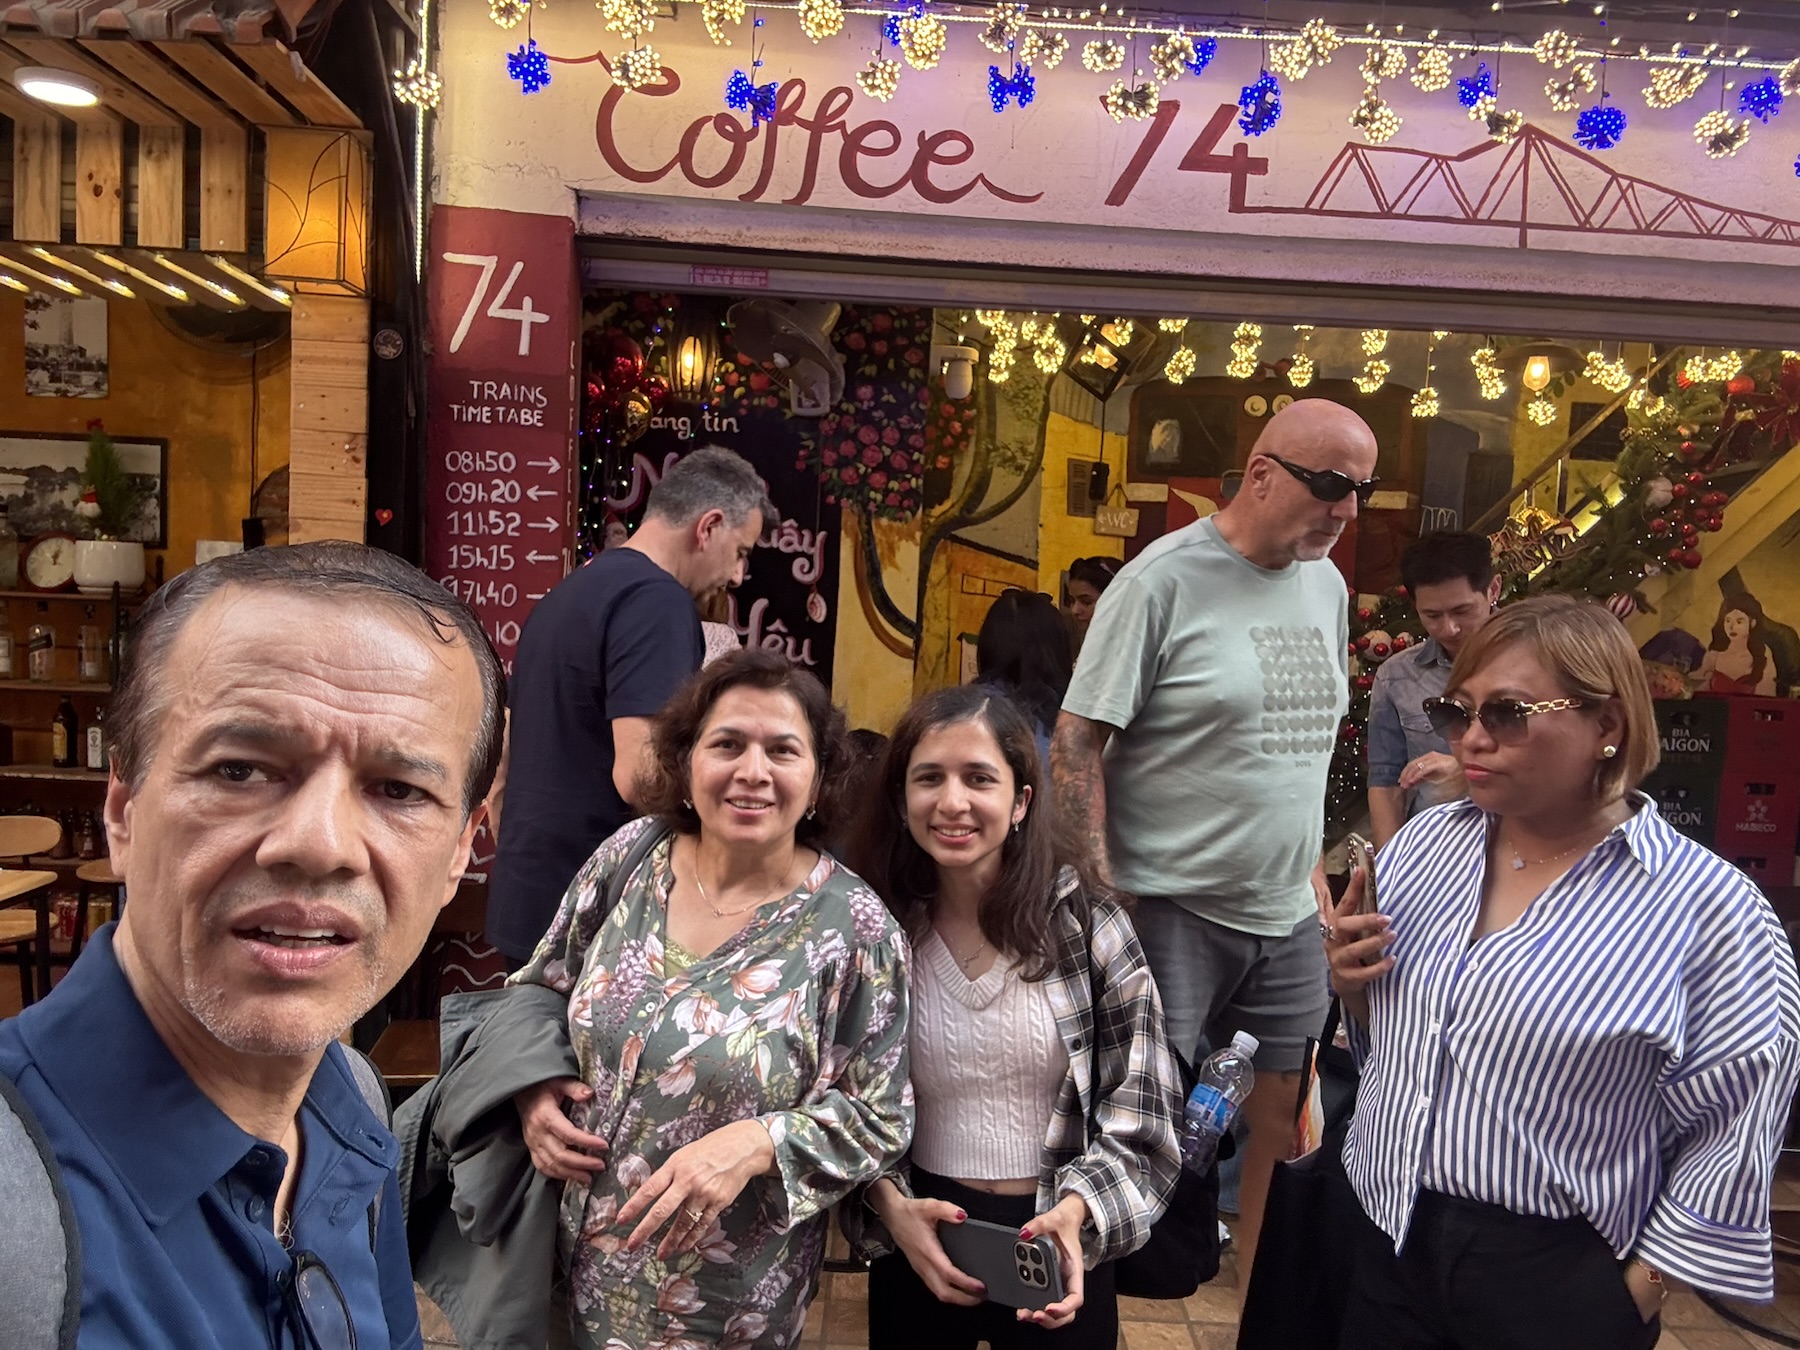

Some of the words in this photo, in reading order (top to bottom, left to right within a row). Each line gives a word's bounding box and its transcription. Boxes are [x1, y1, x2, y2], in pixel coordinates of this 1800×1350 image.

[547, 50, 1044, 206] Coffee
[1099, 95, 1268, 214] 74
[442, 252, 550, 356] 74
[469, 380, 547, 408] TRAINS
[702, 411, 740, 433] tin
[445, 450, 517, 473] 08h50
[445, 479, 522, 504] 09h20
[446, 510, 521, 537] 11h52
[1106, 511, 1130, 529] WC
[447, 544, 515, 571] 15h15
[1661, 737, 1710, 752] AIGON
[1671, 727, 1690, 738] BIA
[1663, 801, 1682, 811] BIA
